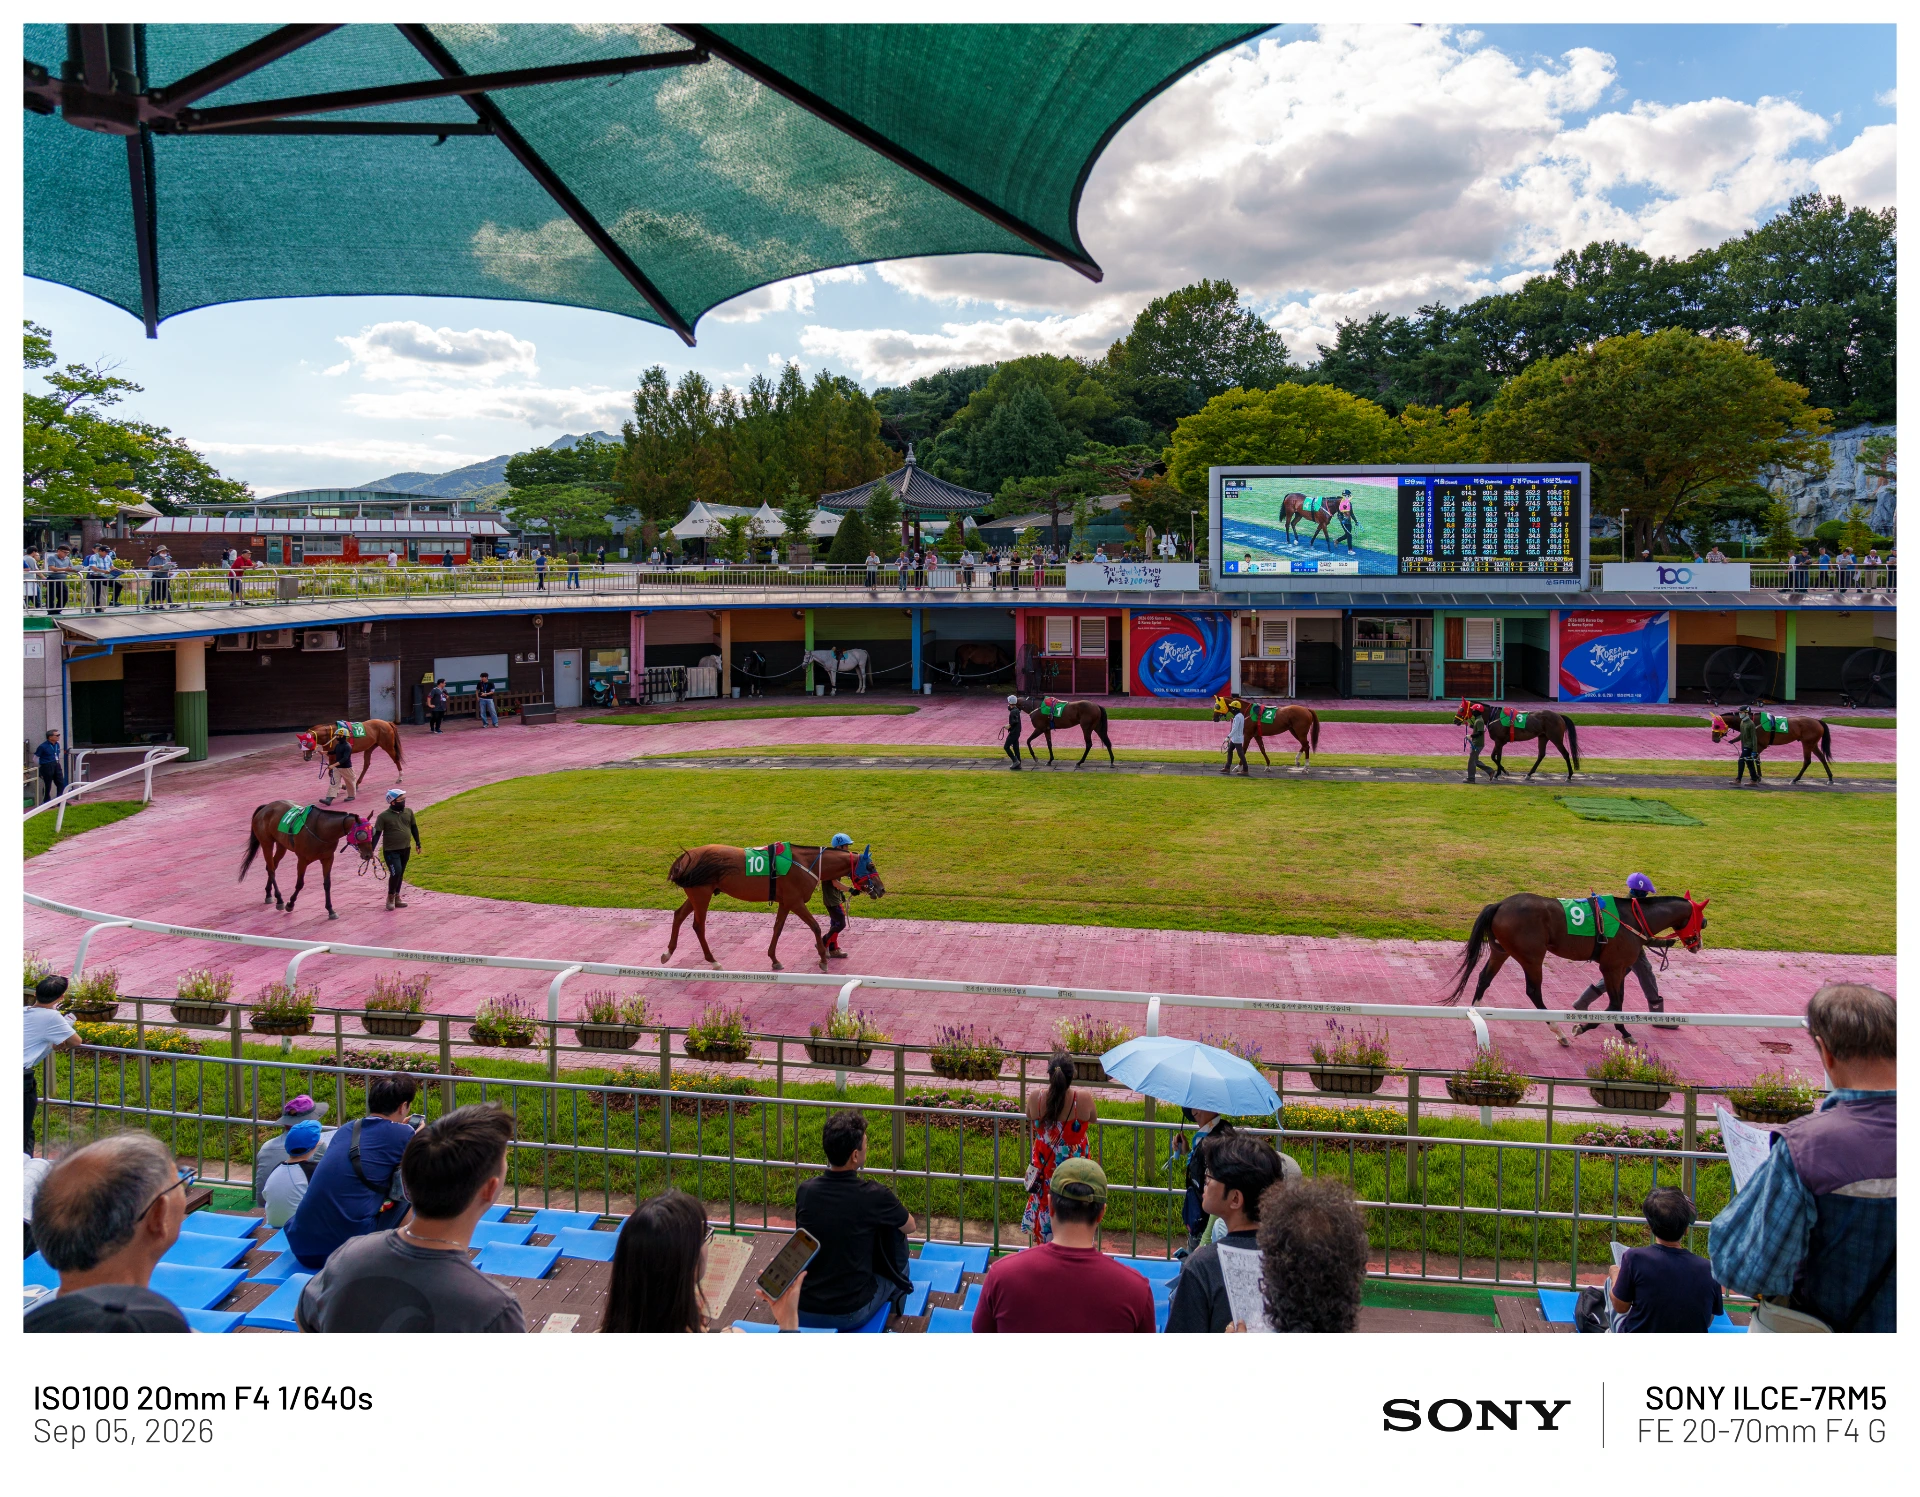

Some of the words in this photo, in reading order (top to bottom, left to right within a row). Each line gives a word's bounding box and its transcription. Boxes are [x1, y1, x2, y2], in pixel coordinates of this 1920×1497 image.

[1656, 566, 1693, 584] 100
[1177, 650, 1191, 662] CUP
[1056, 707, 1062, 716] 1
[1265, 711, 1272, 719] 2
[1516, 714, 1523, 722] 3
[1780, 722, 1787, 731] 4
[748, 856, 764, 873] 10
[1570, 906, 1585, 926] 9
